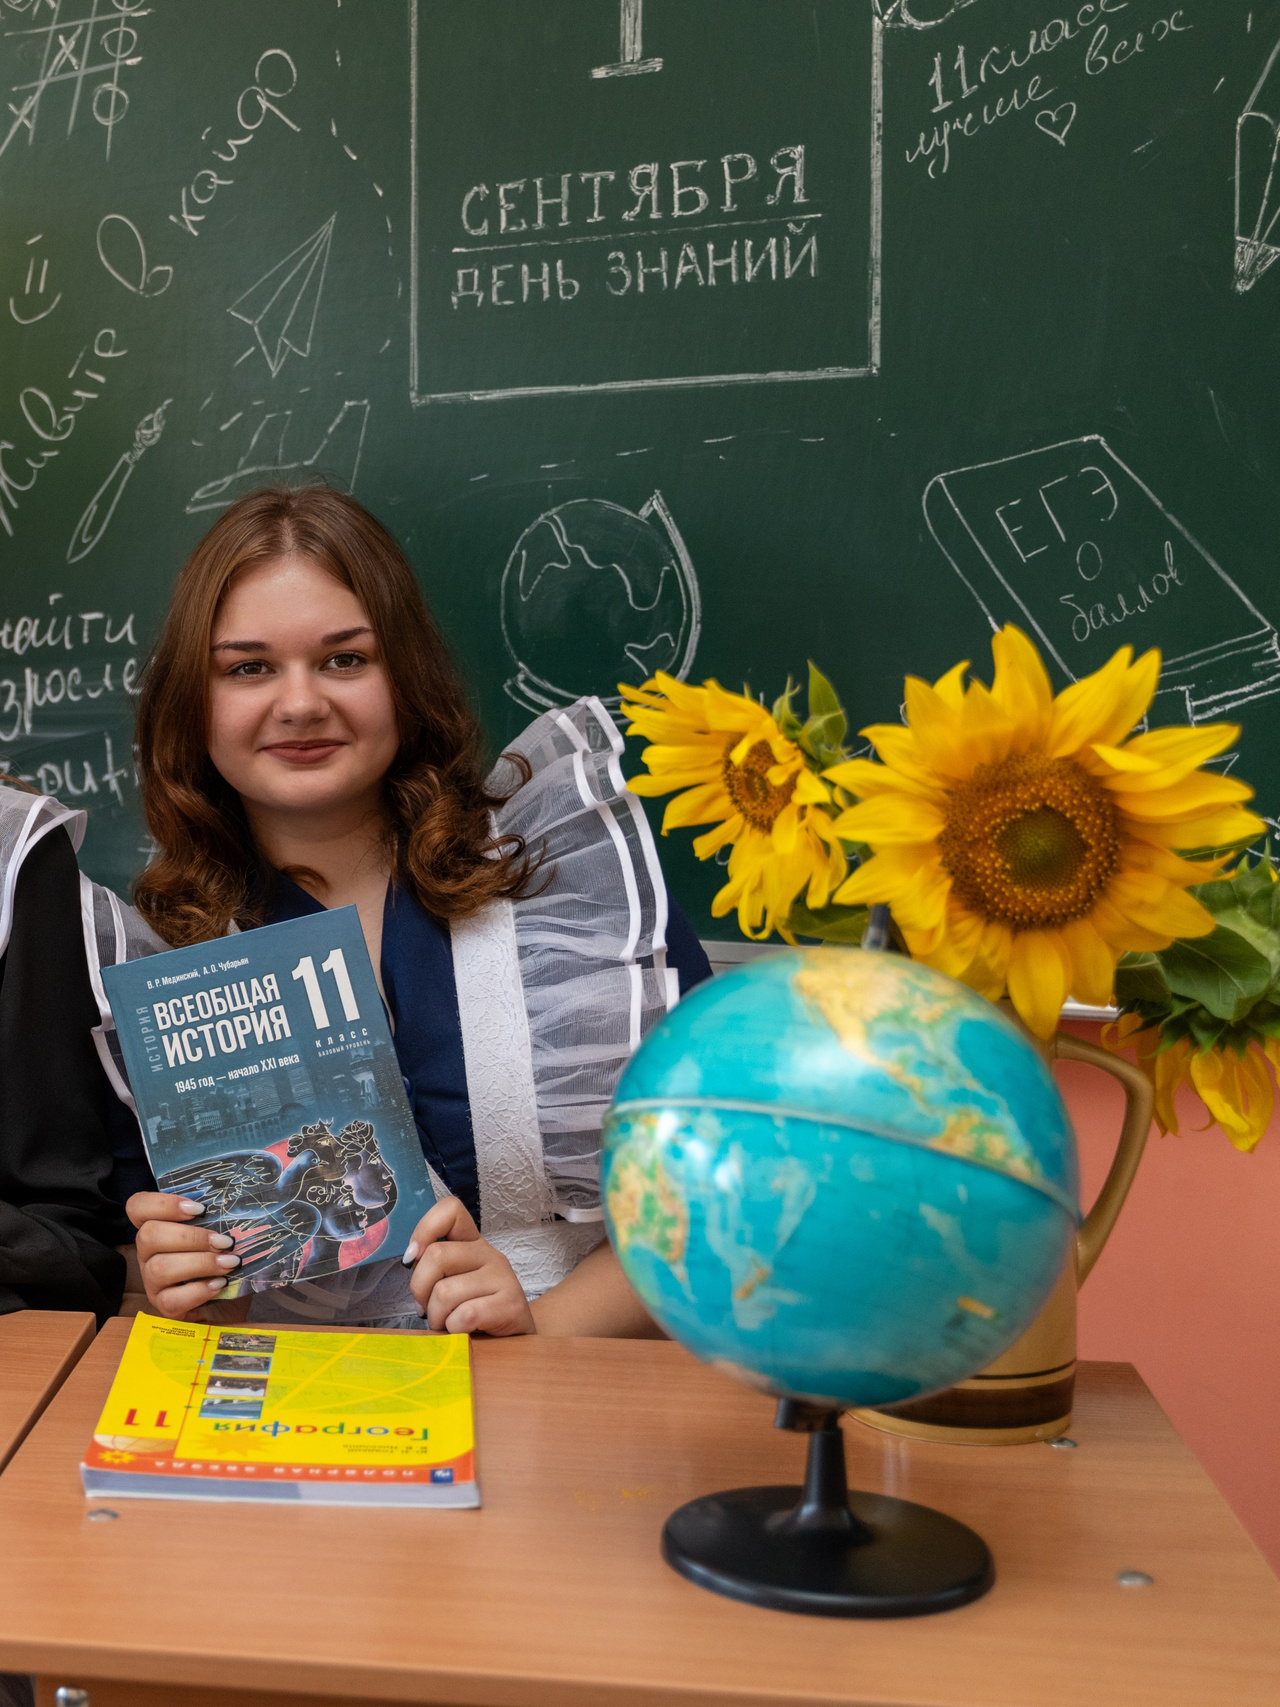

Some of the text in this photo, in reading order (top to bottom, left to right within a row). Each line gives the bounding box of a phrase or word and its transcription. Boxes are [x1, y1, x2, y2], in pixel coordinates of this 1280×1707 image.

[905, 75, 1059, 179] лучше
[461, 143, 811, 236] СЕНТЯБРЯ
[451, 221, 819, 310] ДЕНЬ ЗНАНИЙ
[995, 466, 1118, 563] ЕГЭ
[1059, 540, 1187, 642] баллов
[146, 980, 155, 990] В.
[155, 978, 162, 988] Р.
[203, 966, 211, 975] А.
[219, 957, 250, 972] Чубарьян
[152, 973, 281, 1031] ВСЕОБЩАЯ
[291, 948, 361, 1030] 11
[136, 1006, 164, 1073] ИСТОРИЯ
[161, 1005, 292, 1068] ИСТОРИЯ
[315, 1028, 368, 1048] класс
[318, 1039, 371, 1057] БАЗОВЫЙ УРОВЕНЬ
[174, 1077, 197, 1094] 1945
[198, 1076, 215, 1088] год
[228, 1063, 260, 1080] начало
[278, 1053, 300, 1068] века
[124, 1408, 169, 1428] 11
[214, 1420, 428, 1441] География
